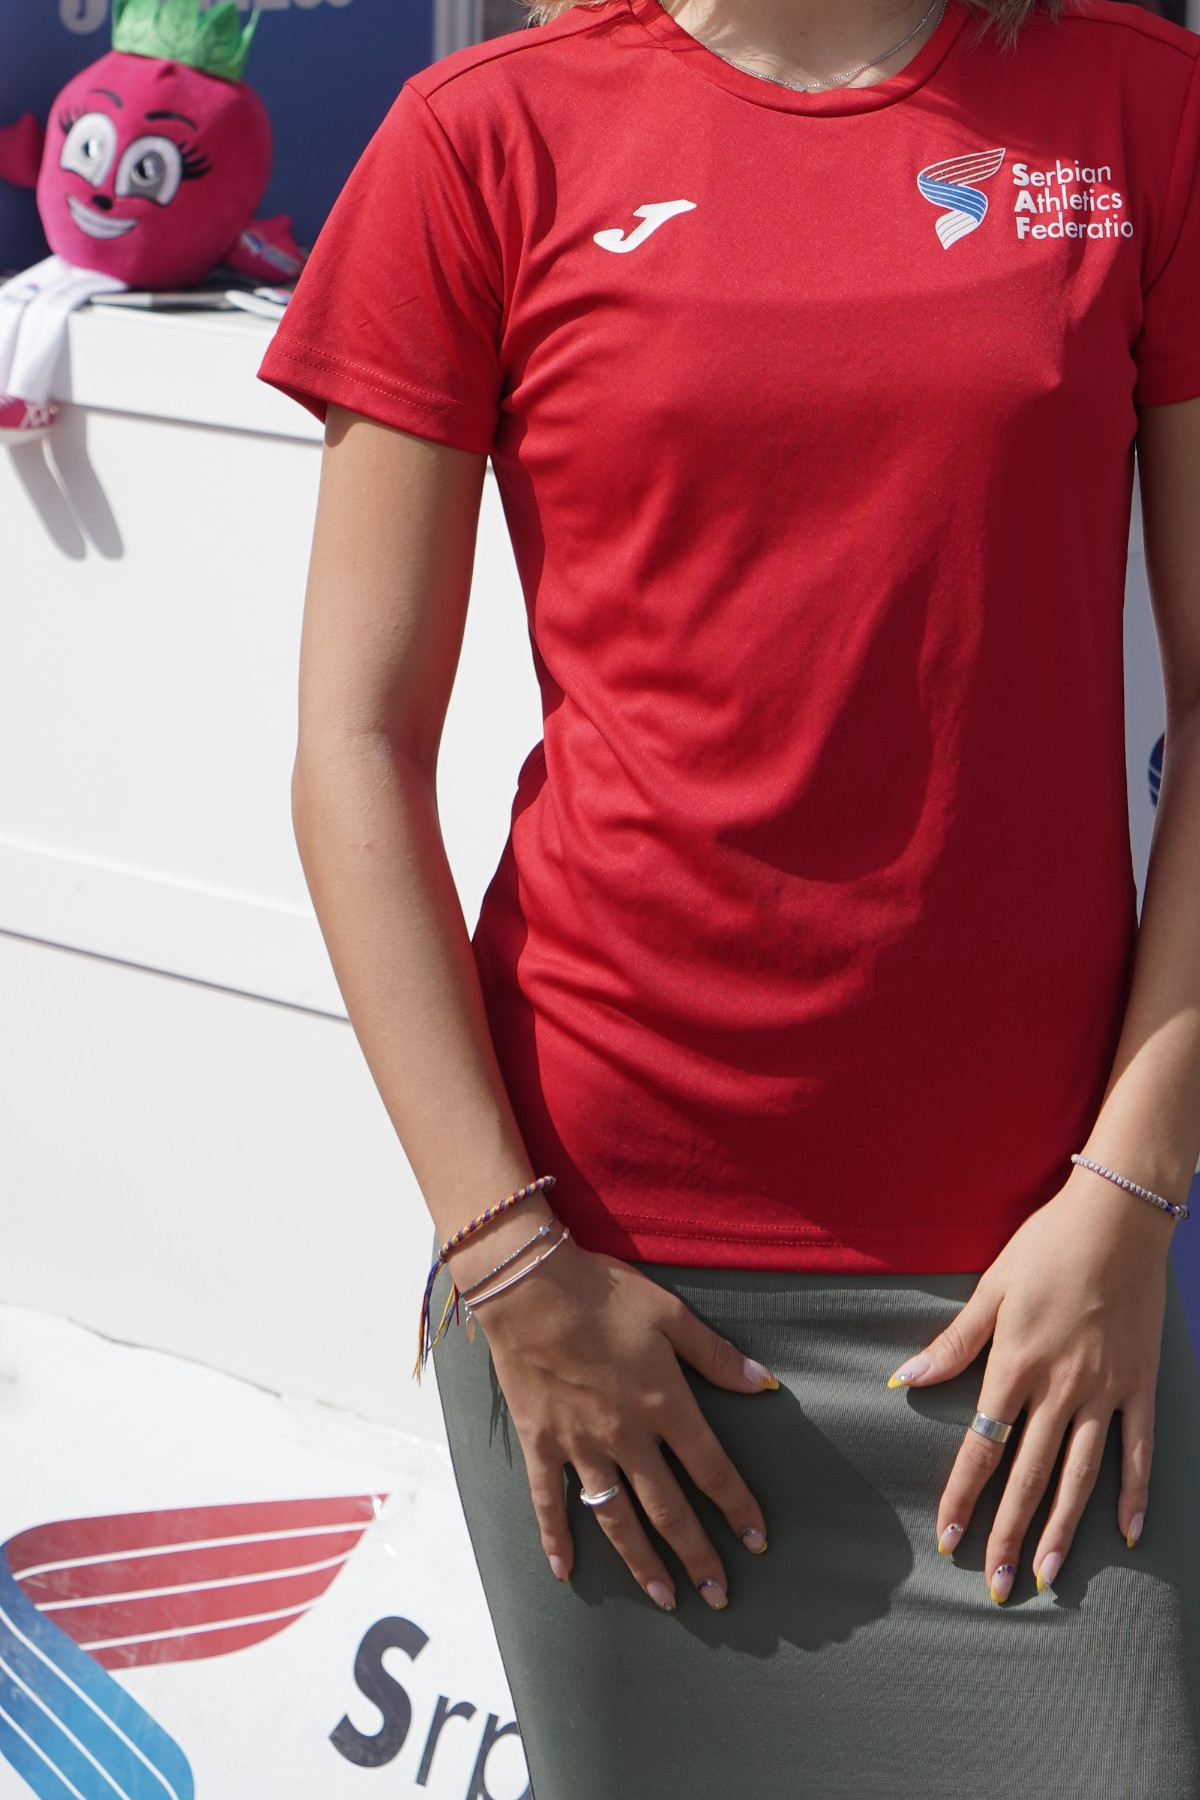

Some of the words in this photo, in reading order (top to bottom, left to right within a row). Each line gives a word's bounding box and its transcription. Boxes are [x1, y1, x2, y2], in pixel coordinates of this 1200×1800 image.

[1012, 159, 1112, 188] Serbian
[1013, 185, 1124, 215] Athletics
[1015, 211, 1134, 240] Federatio
